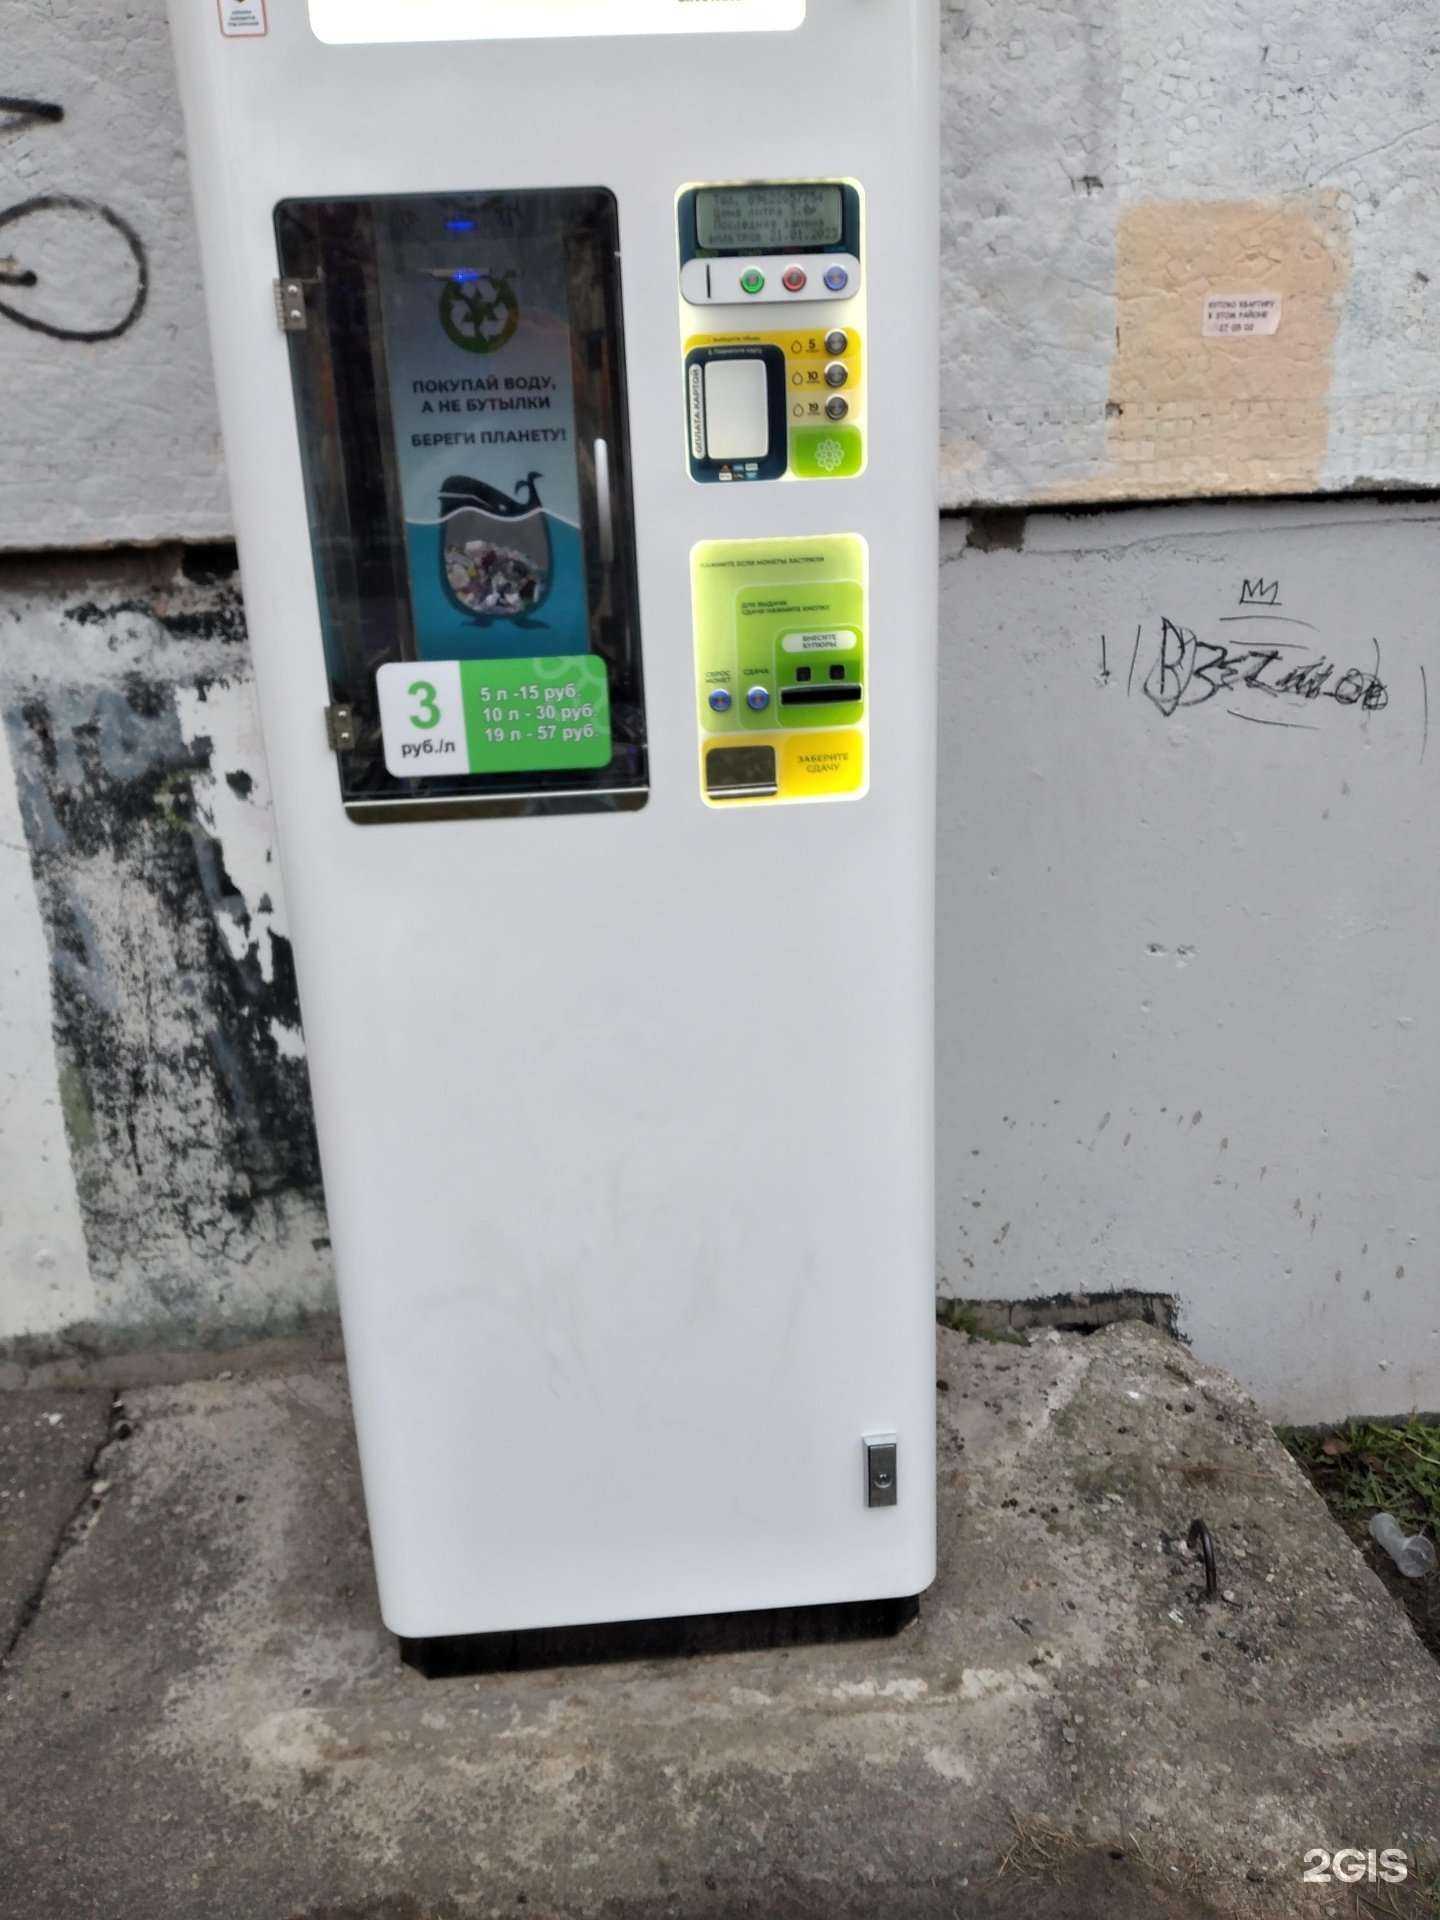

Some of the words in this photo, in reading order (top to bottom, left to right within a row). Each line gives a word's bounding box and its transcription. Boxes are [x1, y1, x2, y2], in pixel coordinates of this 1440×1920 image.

[808, 338, 816, 350] 5
[807, 370, 818, 381] 10
[412, 375, 499, 394] ПОКУПАЙ
[505, 376, 557, 392] ВОДУ,
[421, 401, 434, 414] А
[439, 400, 463, 413] НЕ
[466, 397, 551, 412] БУТЫЛКИ
[808, 402, 819, 412] 19
[411, 431, 476, 447] БЕРЕГИ
[481, 428, 567, 444] ПЛАНЕТУ!
[480, 687, 492, 702] 5
[496, 689, 508, 701] л
[407, 680, 442, 730] 3
[483, 706, 503, 722] 10
[508, 708, 520, 721] л
[536, 704, 556, 720] 30
[485, 727, 504, 742] 19
[510, 729, 521, 741] л
[537, 725, 557, 741] 57
[401, 738, 456, 758] руб./л
[797, 752, 849, 763] ЗАБЕРИТЕ
[806, 762, 839, 773] СДАЧУ
